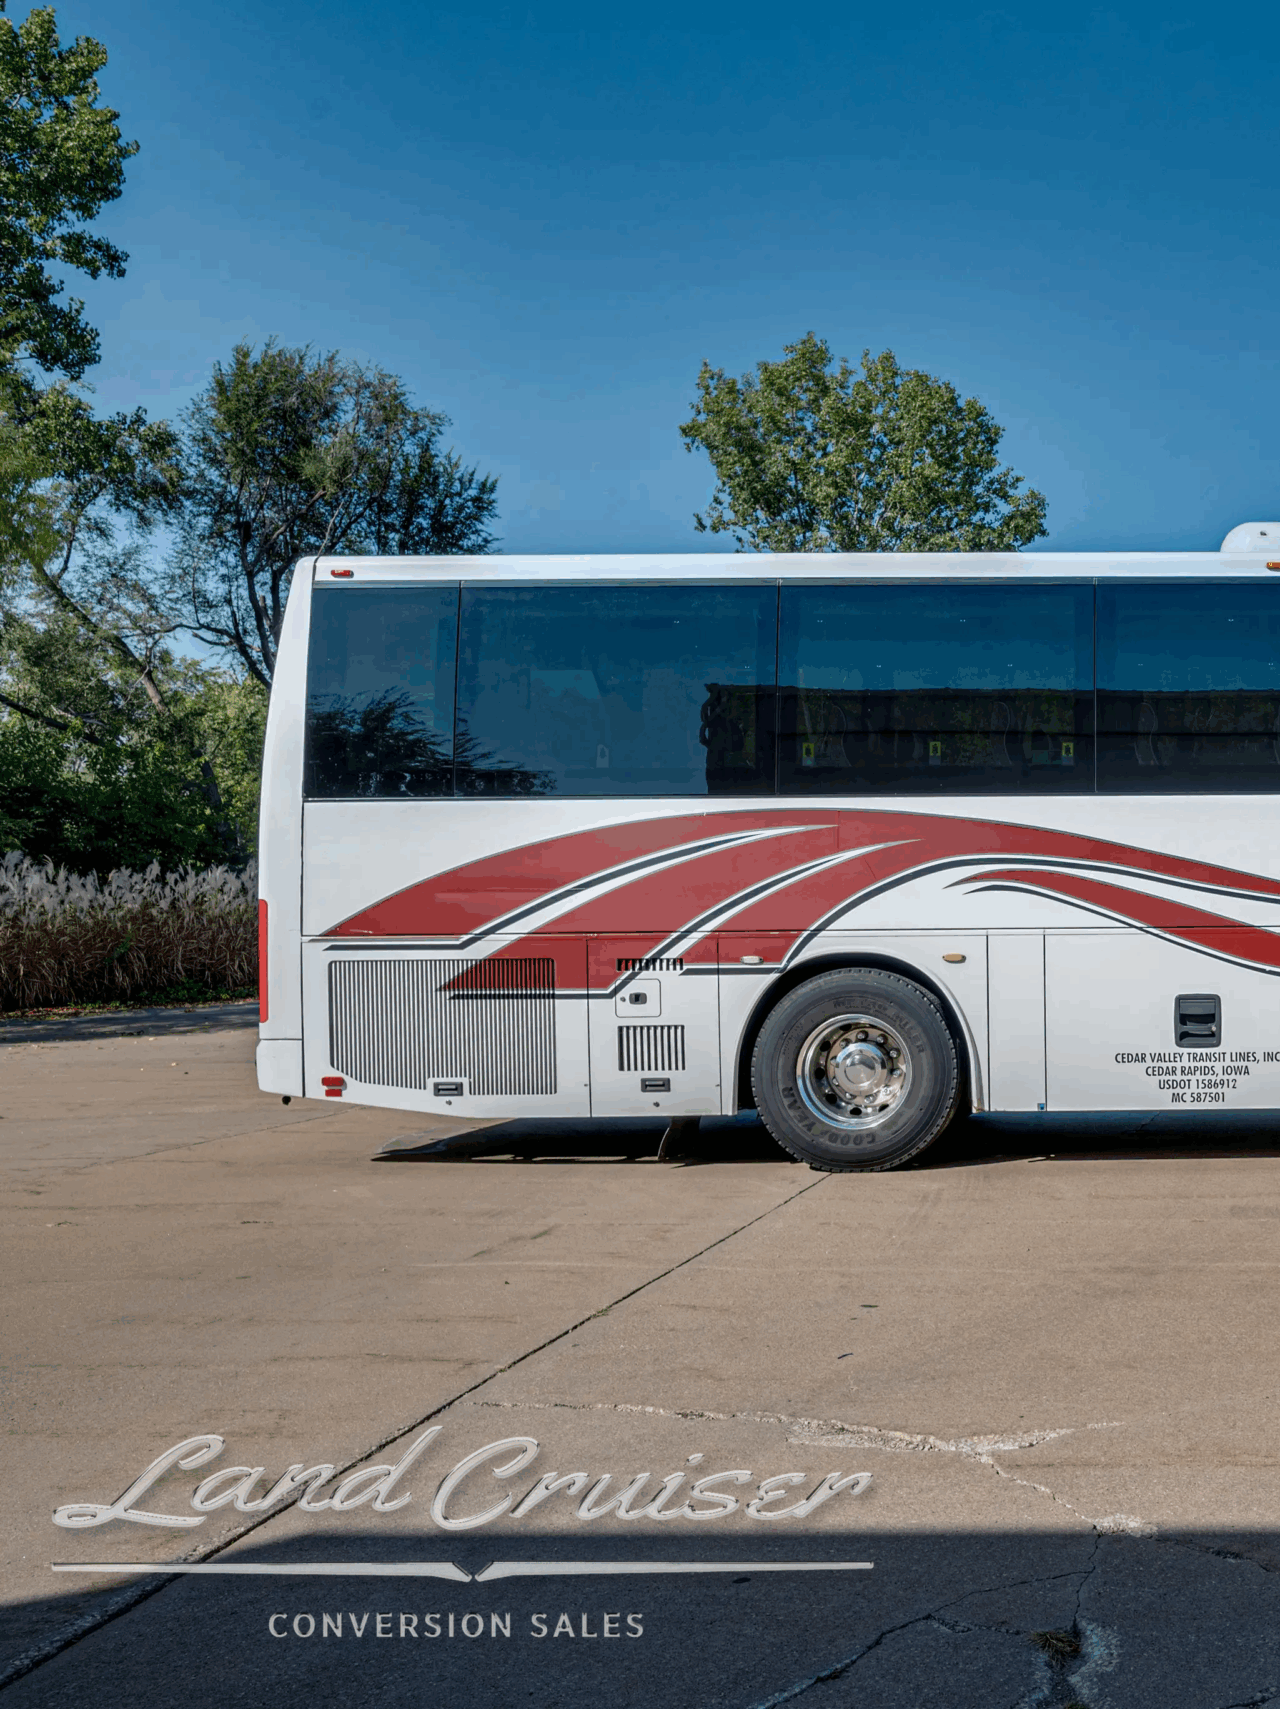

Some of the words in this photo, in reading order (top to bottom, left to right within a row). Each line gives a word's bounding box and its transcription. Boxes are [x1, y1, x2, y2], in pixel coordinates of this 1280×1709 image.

[1114, 1052, 1147, 1064] CEDAR
[1149, 1052, 1184, 1063] VALLEY
[1186, 1052, 1227, 1063] TRANSIT
[1230, 1051, 1260, 1064] LINES,
[1263, 1051, 1280, 1062] INC
[1145, 1066, 1178, 1077] CEDAR
[1180, 1065, 1219, 1077] RAPIDS,
[1222, 1065, 1250, 1076] IOWA
[1158, 1079, 1192, 1090] USDOT
[1196, 1079, 1237, 1089] 1586912
[1171, 1092, 1187, 1103] MC
[1190, 1092, 1225, 1103] 587501
